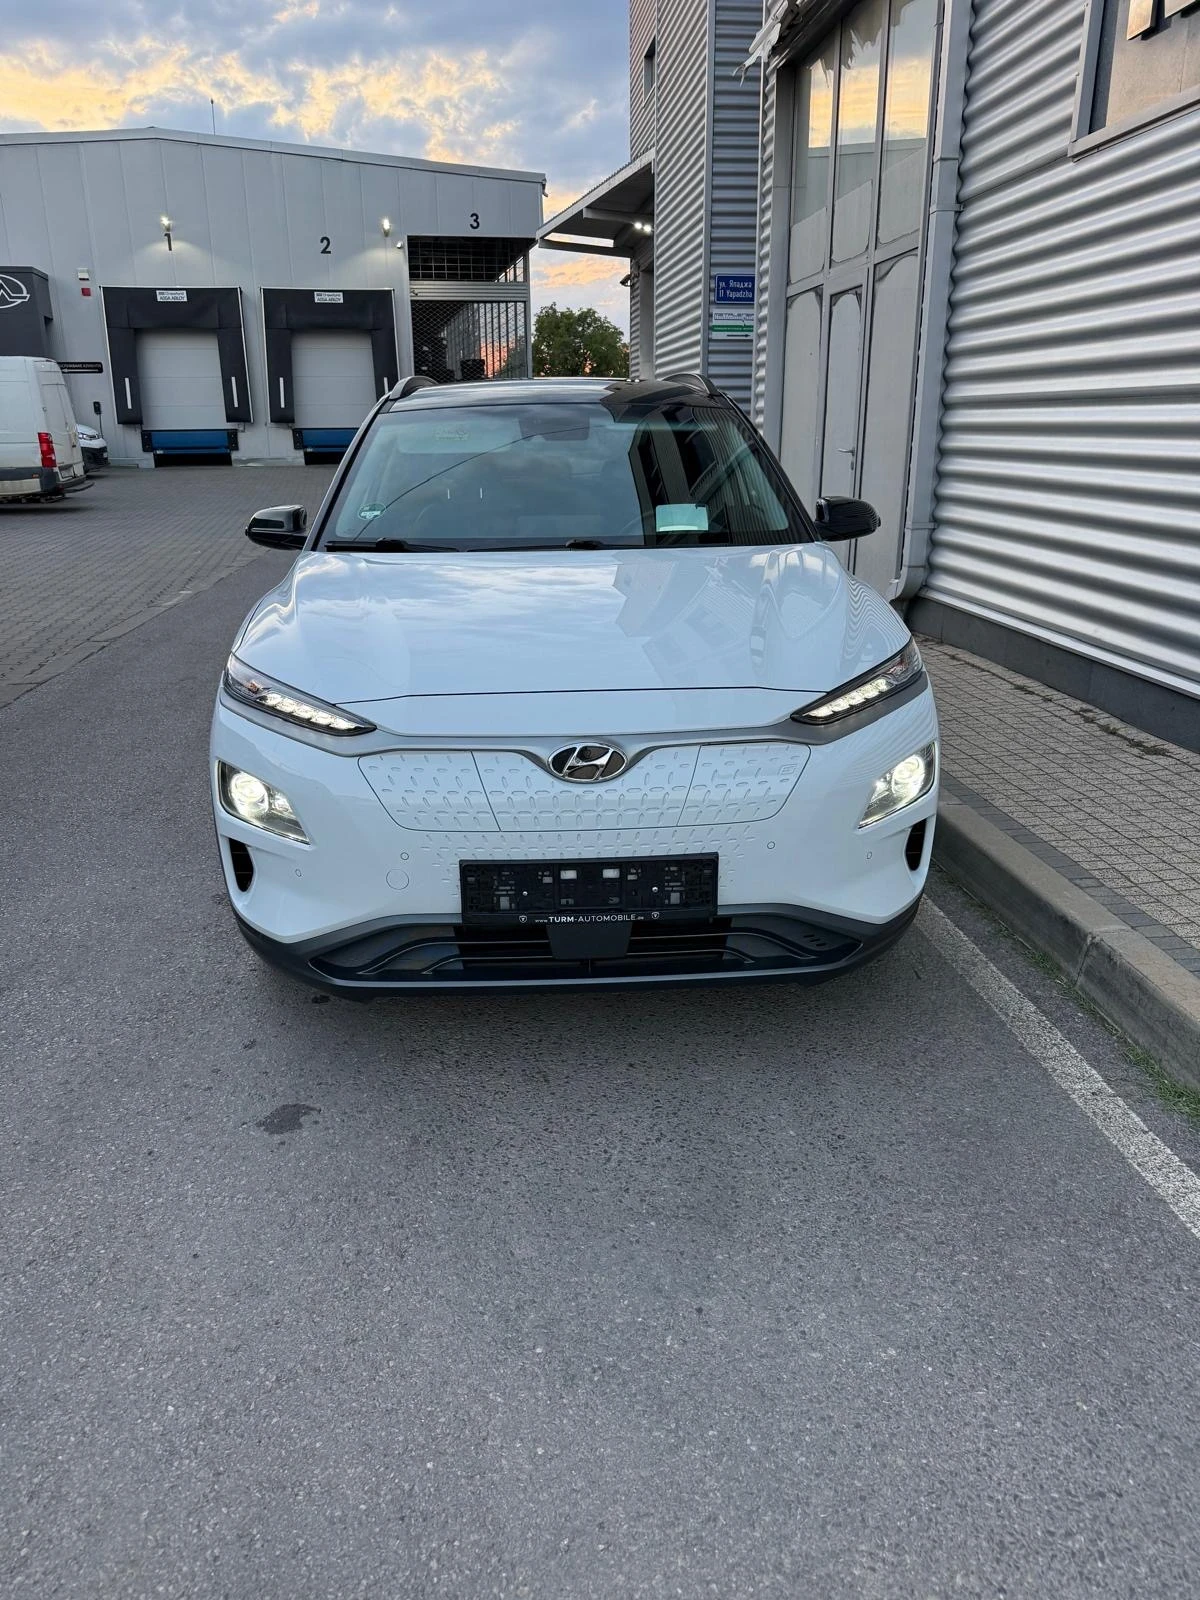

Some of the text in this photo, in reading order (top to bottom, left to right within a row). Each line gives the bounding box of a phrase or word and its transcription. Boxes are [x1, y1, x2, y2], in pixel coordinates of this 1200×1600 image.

[470, 213, 480, 229] 3
[164, 233, 172, 251] 1
[320, 237, 332, 254] 2
[726, 288, 753, 299] Yapadzha
